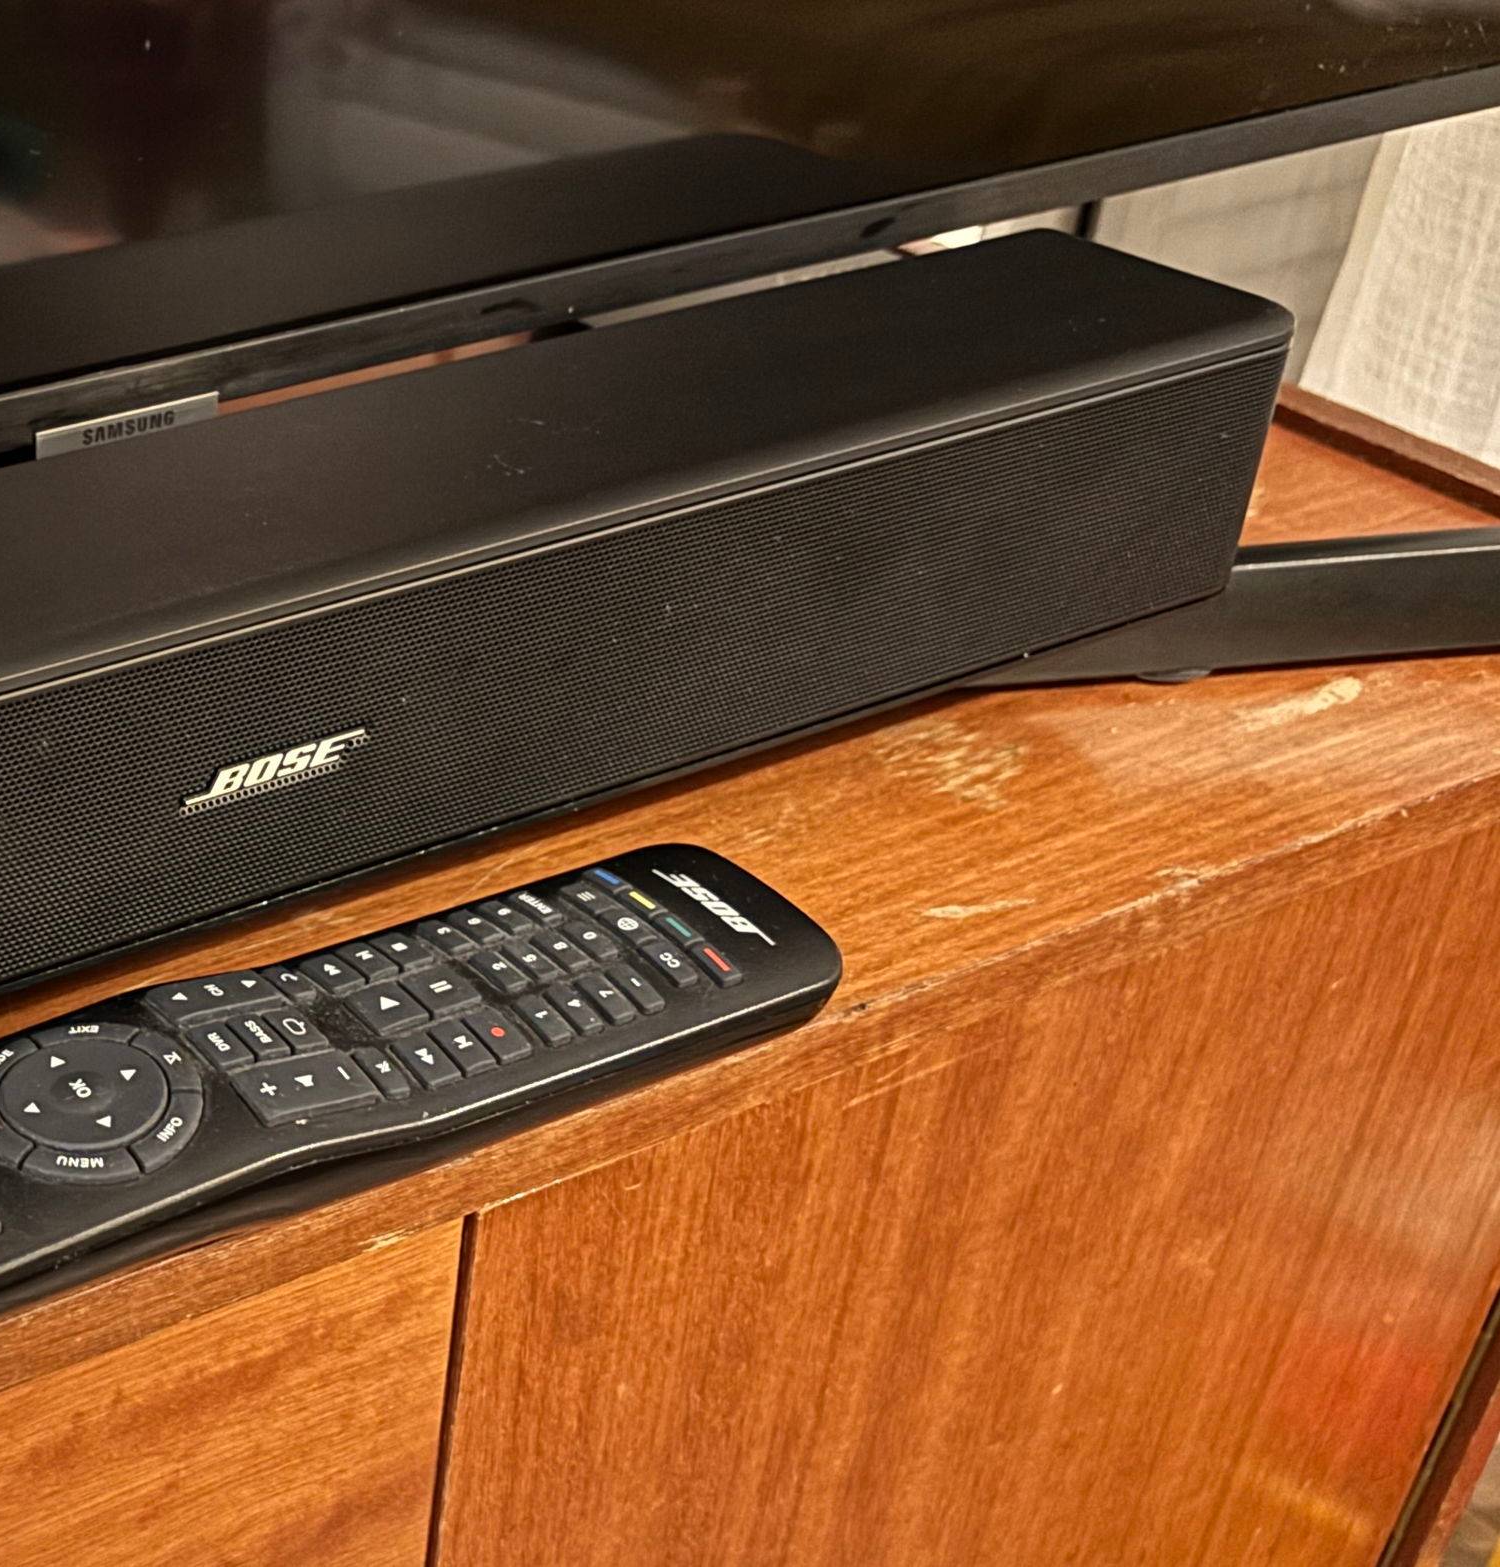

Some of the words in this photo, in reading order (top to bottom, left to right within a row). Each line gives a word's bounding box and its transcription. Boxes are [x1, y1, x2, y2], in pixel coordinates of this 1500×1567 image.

[82, 410, 175, 446] SAMSUNG
[185, 728, 367, 807] BOSE
[518, 893, 553, 915] ENTER
[652, 868, 776, 946] BOSE
[522, 953, 537, 963] 5
[659, 952, 681, 968] CC
[492, 962, 507, 971] 2
[203, 984, 224, 997] CH
[599, 989, 614, 999] 7
[567, 998, 581, 1008] 4
[535, 1010, 548, 1019] 1
[68, 1025, 100, 1034] EXIT
[244, 1020, 274, 1044] BASS
[207, 1032, 231, 1052] DVR
[68, 1078, 92, 1098] OK
[156, 1116, 183, 1142] INFO
[56, 1155, 104, 1168] MENU
